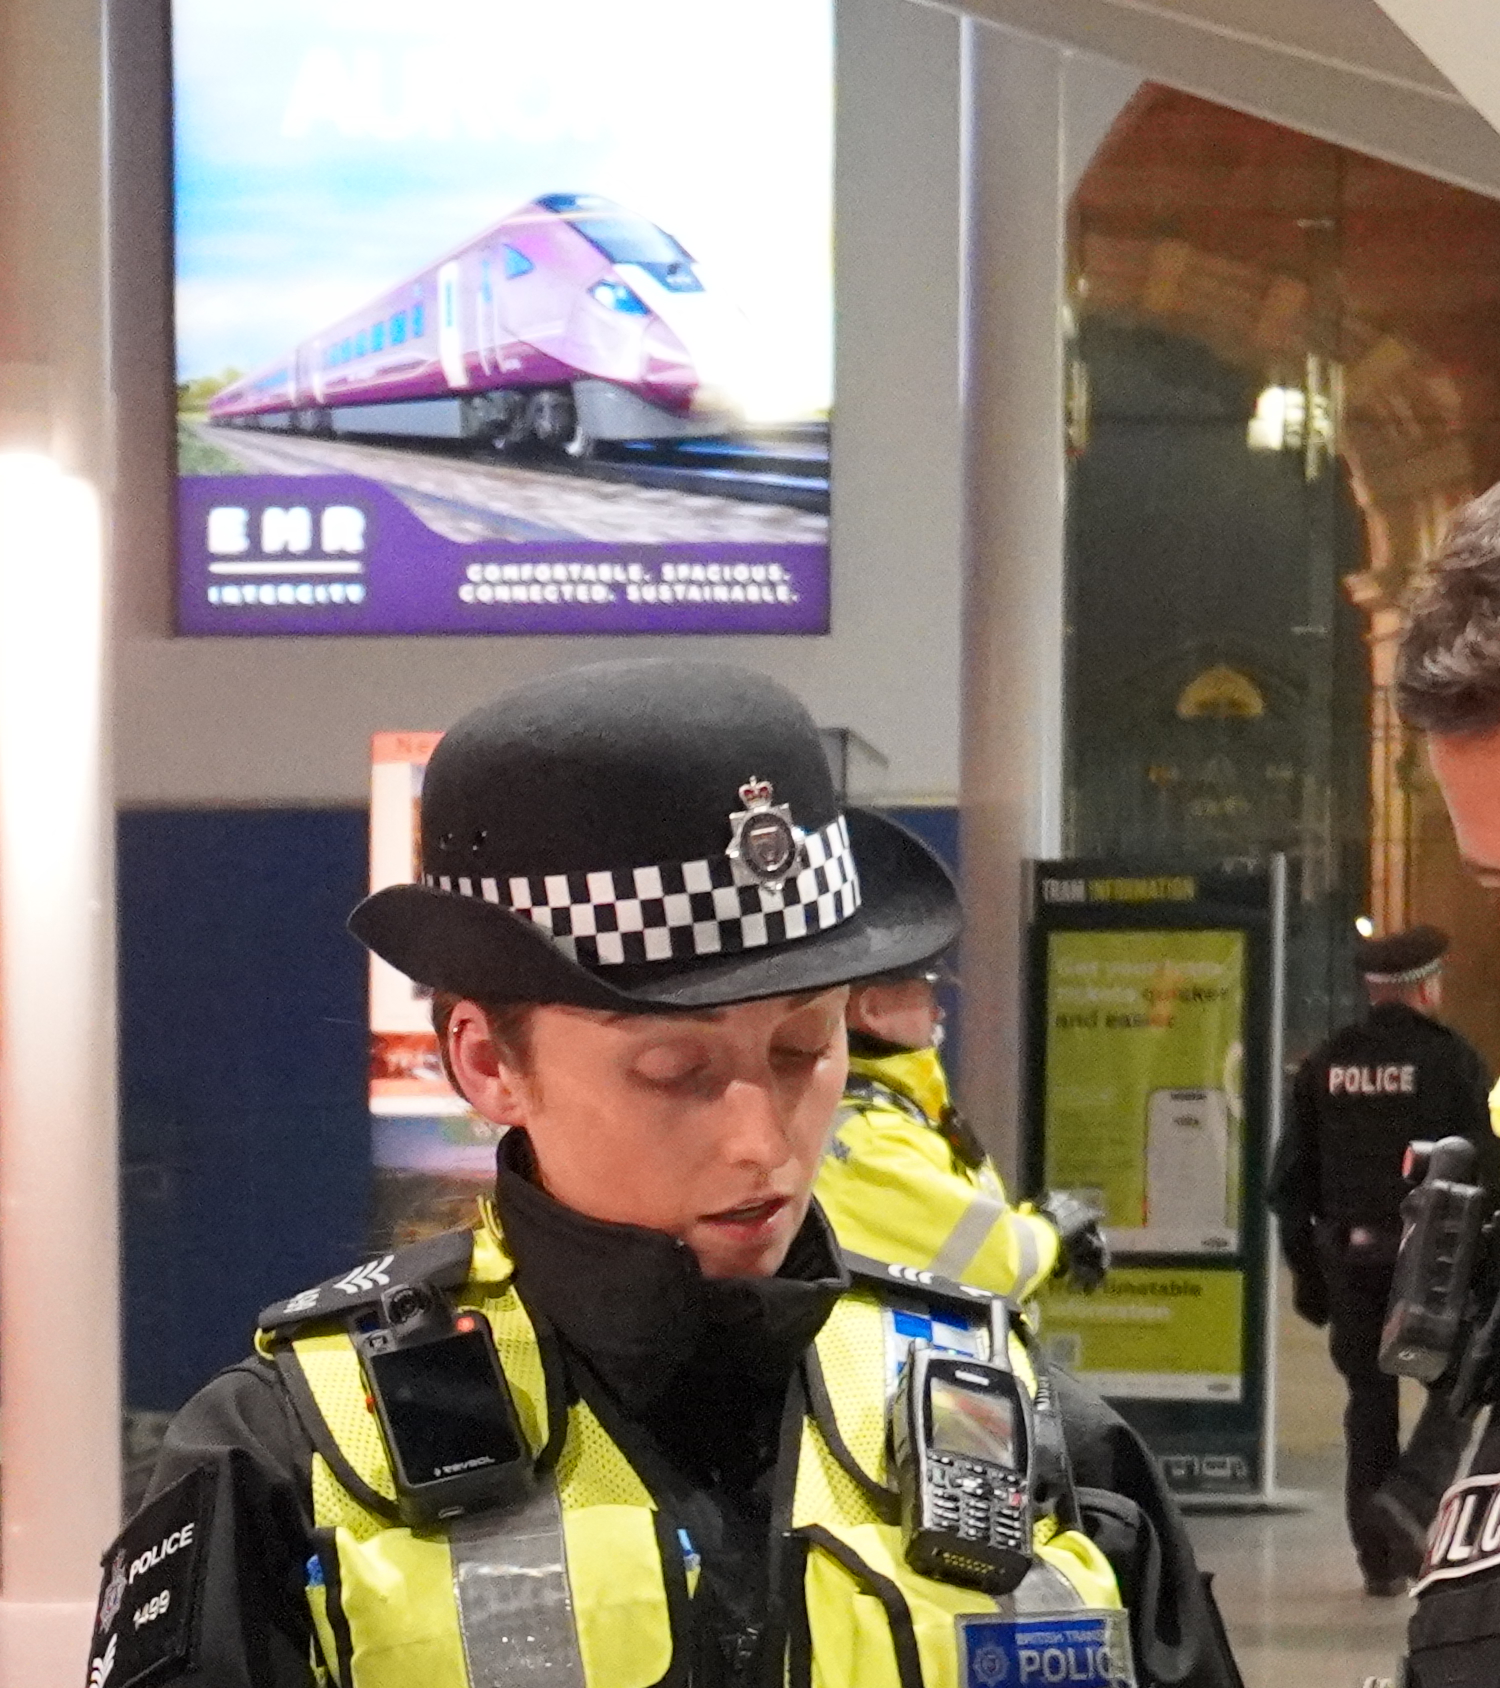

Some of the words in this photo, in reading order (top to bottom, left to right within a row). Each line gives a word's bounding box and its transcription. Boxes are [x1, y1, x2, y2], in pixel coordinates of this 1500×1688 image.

[207, 506, 366, 554] EMR
[458, 583, 616, 603] CONNECTED.
[626, 583, 798, 603] SUSTAINABLE.
[466, 563, 650, 583] COMFORTABLE.
[661, 563, 791, 582] SPACIOUS.
[1329, 1065, 1415, 1093] POLICE
[128, 1522, 195, 1585] POLICE
[133, 1589, 170, 1630] 1499
[1018, 1646, 1122, 1686] POLIC
